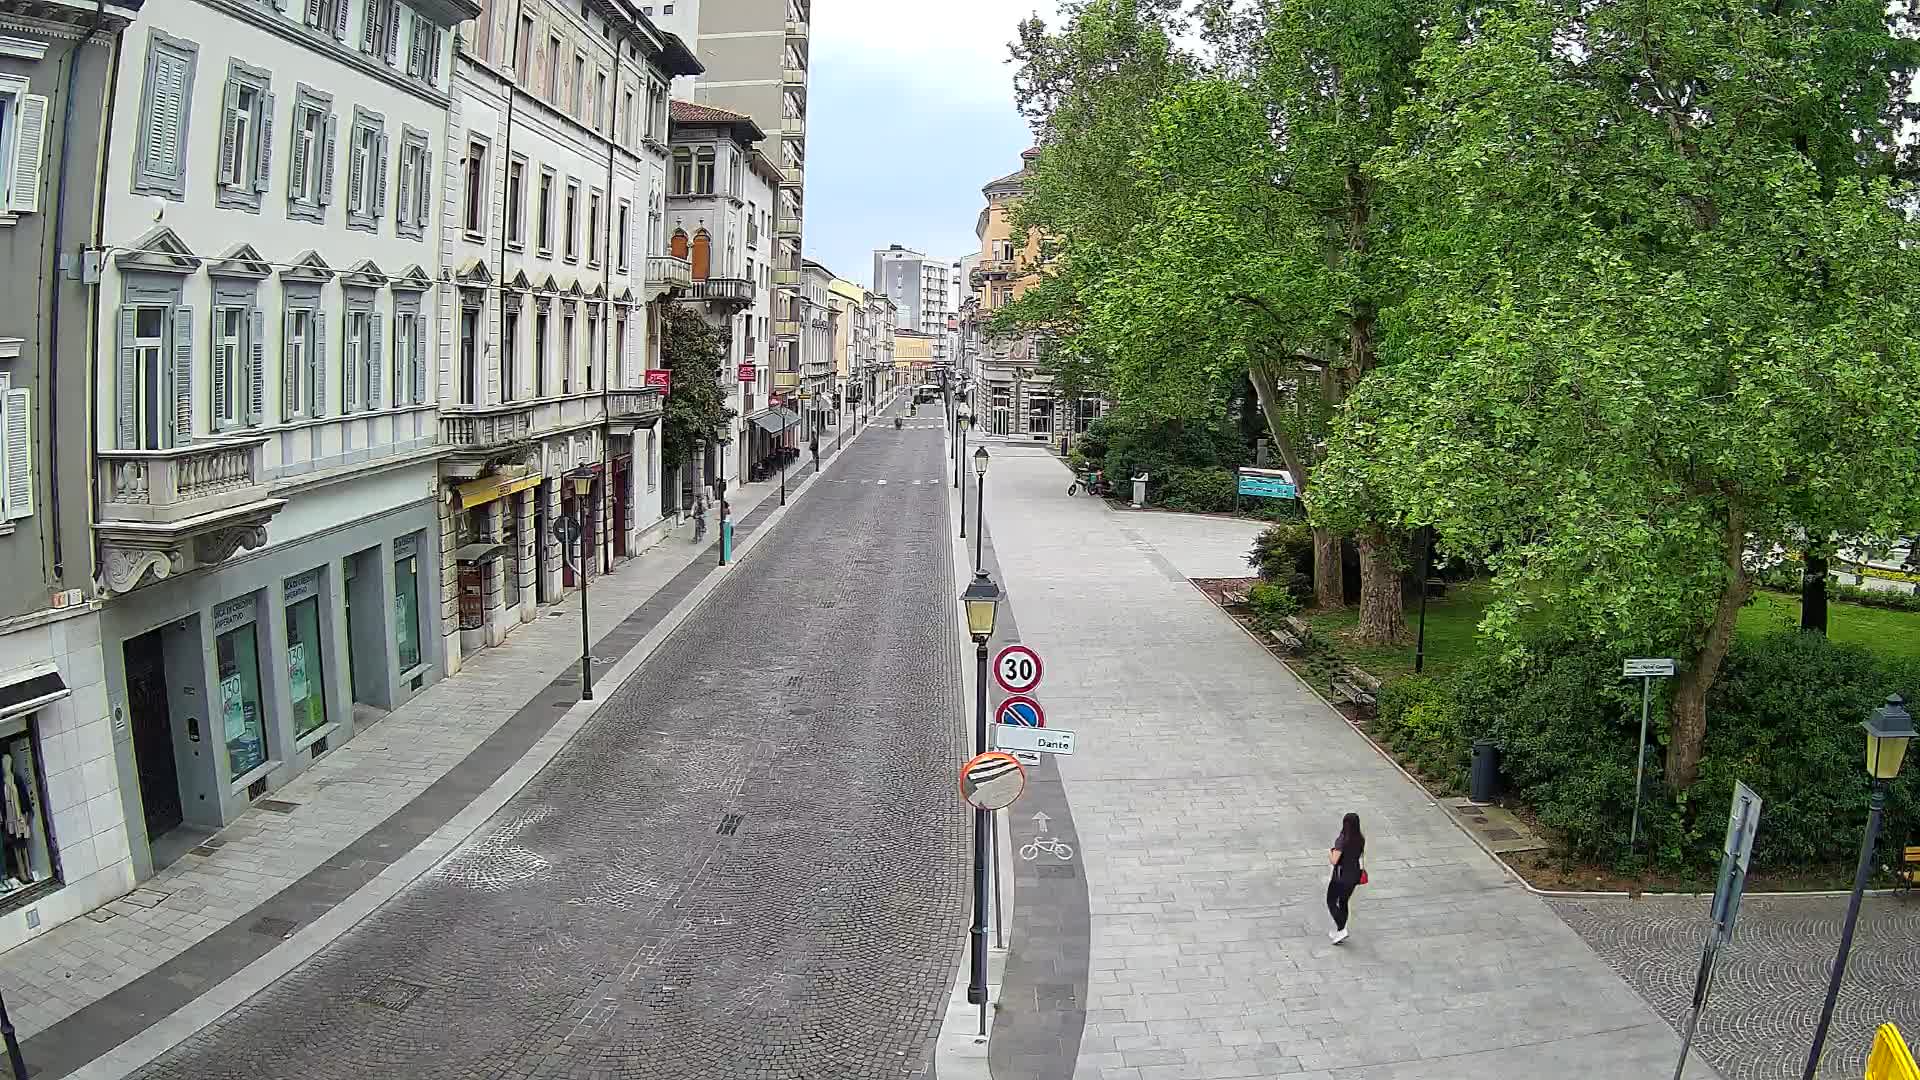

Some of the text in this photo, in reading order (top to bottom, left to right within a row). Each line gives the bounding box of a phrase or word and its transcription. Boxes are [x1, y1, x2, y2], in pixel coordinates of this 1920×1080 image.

[1005, 659, 1033, 680] 30
[221, 678, 240, 702] 130
[1037, 738, 1069, 750] Dante
